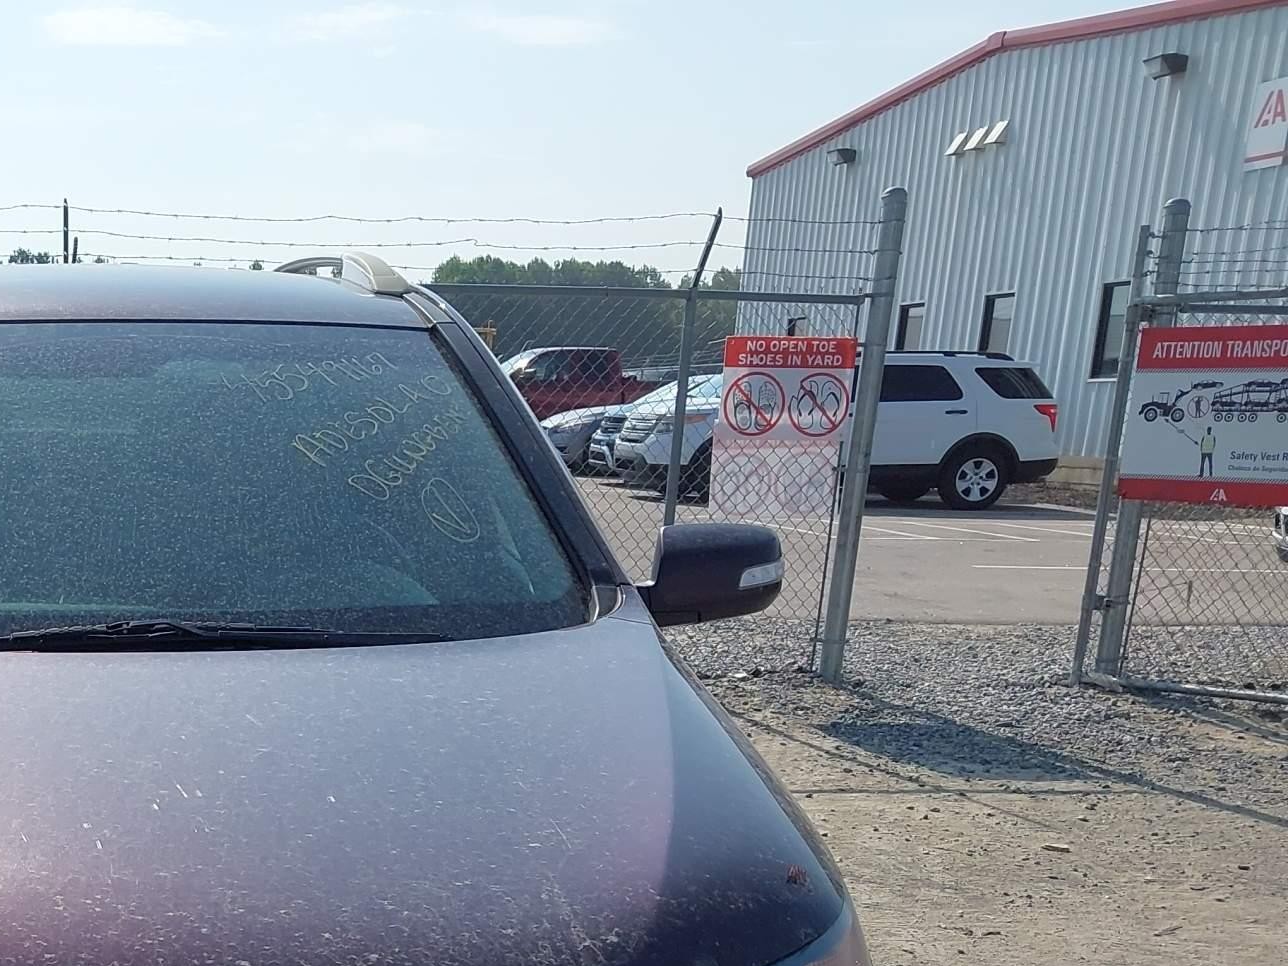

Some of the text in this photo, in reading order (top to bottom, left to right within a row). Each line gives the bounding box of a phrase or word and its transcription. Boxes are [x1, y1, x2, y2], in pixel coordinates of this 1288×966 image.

[746, 341, 836, 353] NO OPEN TOE
[1153, 341, 1222, 359] ATTENTION
[738, 354, 842, 366] SHOES IN YARD
[1230, 451, 1258, 462] Safety
[1261, 452, 1280, 461] Vest
